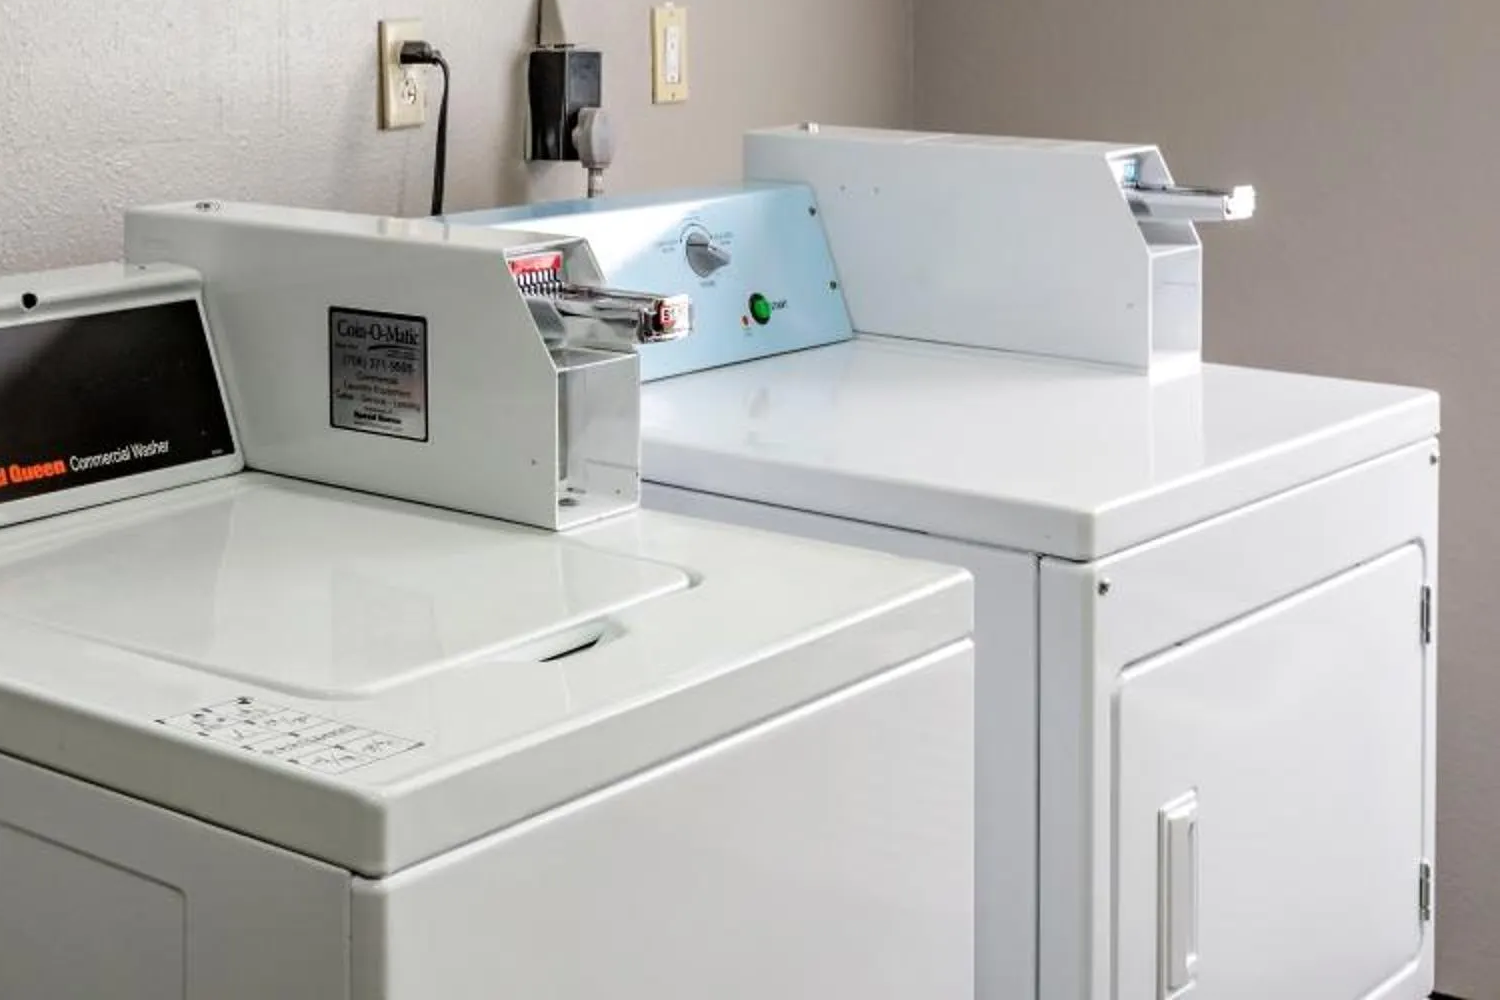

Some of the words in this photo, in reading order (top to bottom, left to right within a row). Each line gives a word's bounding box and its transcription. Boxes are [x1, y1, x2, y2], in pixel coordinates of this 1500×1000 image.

[9, 460, 66, 483] Queen
[69, 446, 131, 472] Commercial
[130, 439, 169, 459] Washer
